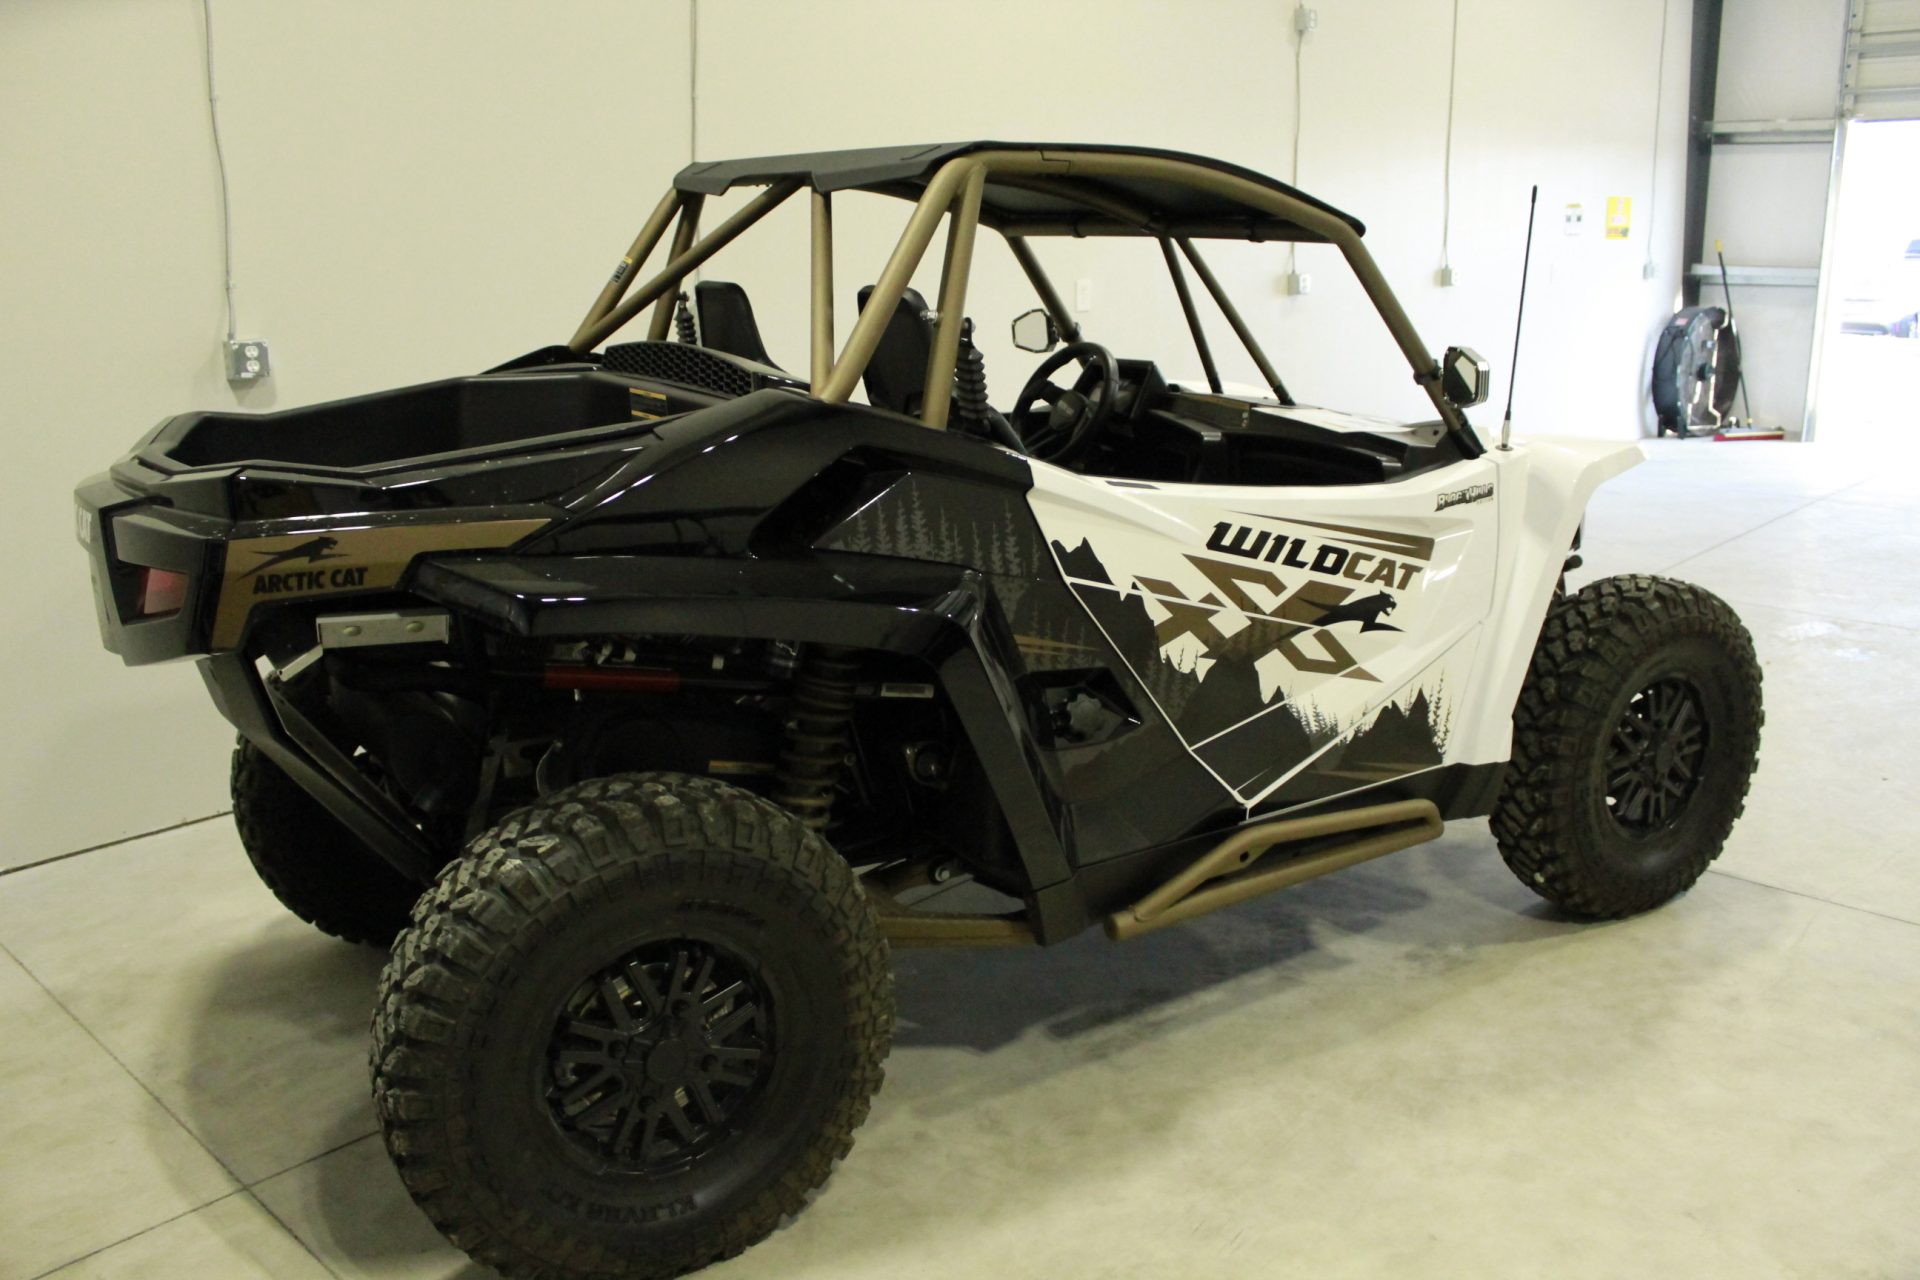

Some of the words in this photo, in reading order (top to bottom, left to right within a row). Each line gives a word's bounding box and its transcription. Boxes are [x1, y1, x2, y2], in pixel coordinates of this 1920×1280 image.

[1206, 521, 1424, 590] WILDCAT
[253, 570, 326, 595] ARCTIC
[329, 566, 369, 589] CAT
